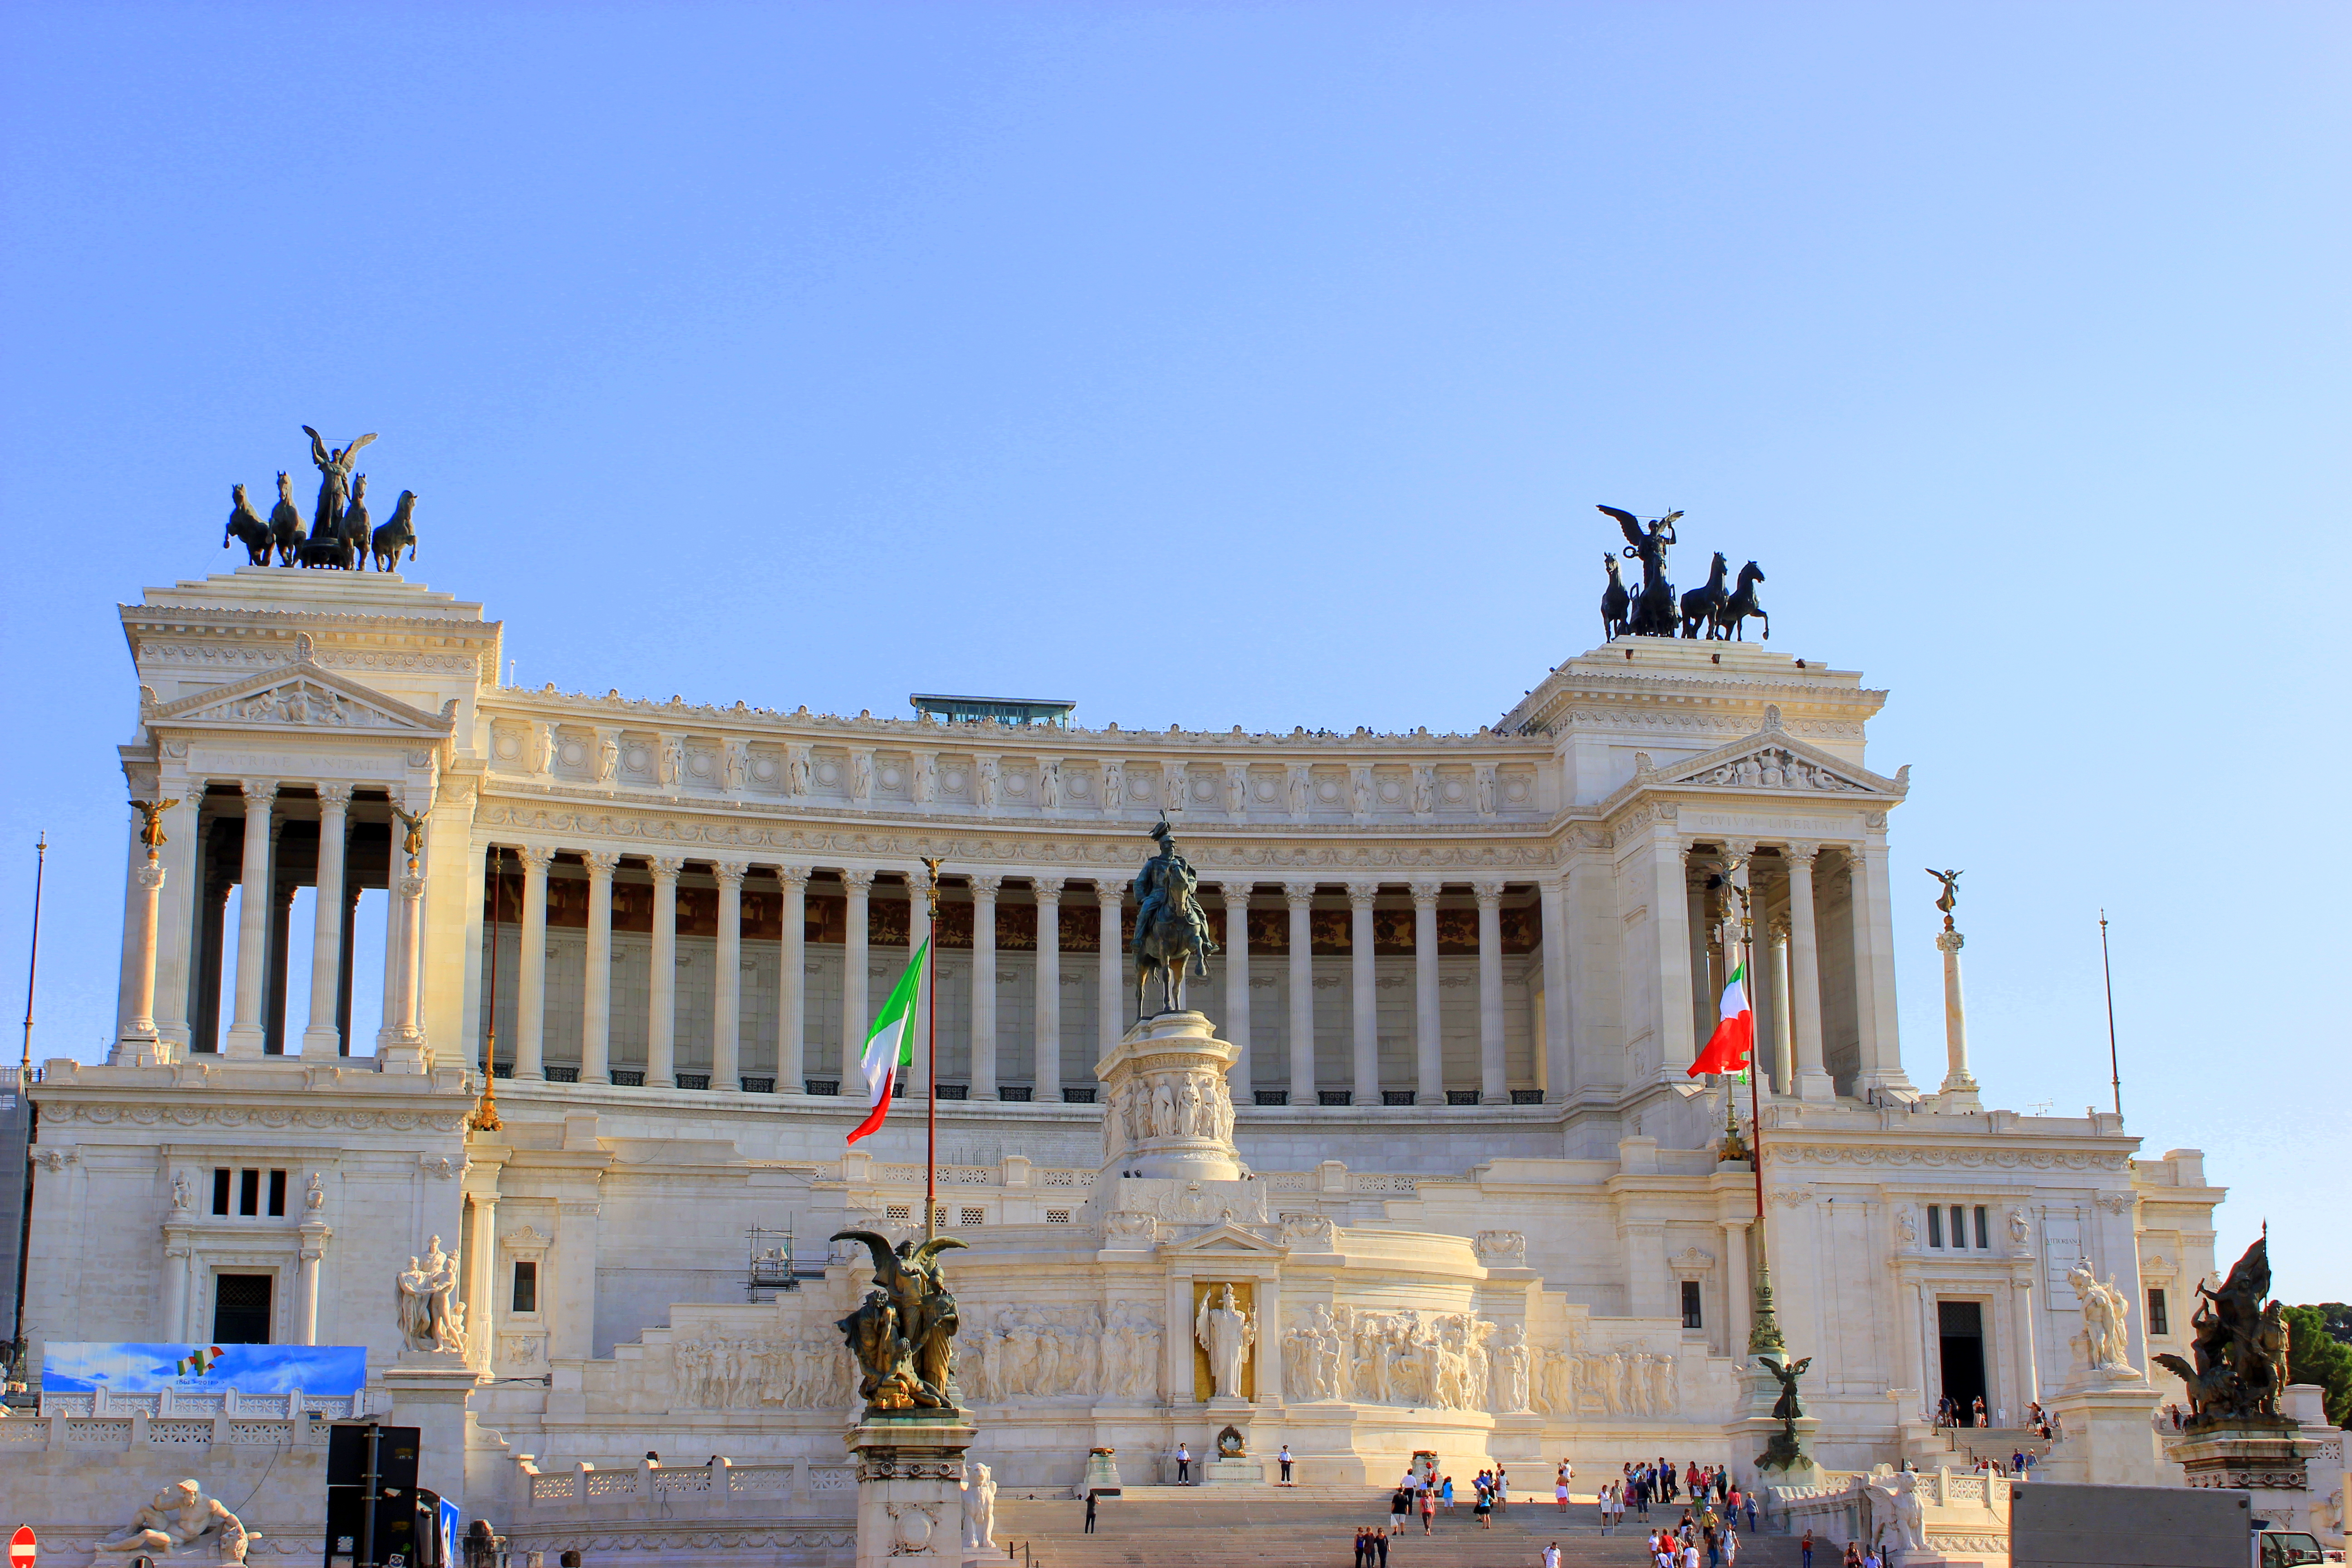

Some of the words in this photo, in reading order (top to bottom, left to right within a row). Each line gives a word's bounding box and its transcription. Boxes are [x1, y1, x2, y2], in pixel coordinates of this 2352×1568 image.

[217, 754, 291, 768] PATRIAE
[310, 758, 379, 771] VNITATI
[1700, 816, 1754, 828] CIVIVM
[1769, 818, 1842, 832] LIBERTATI
